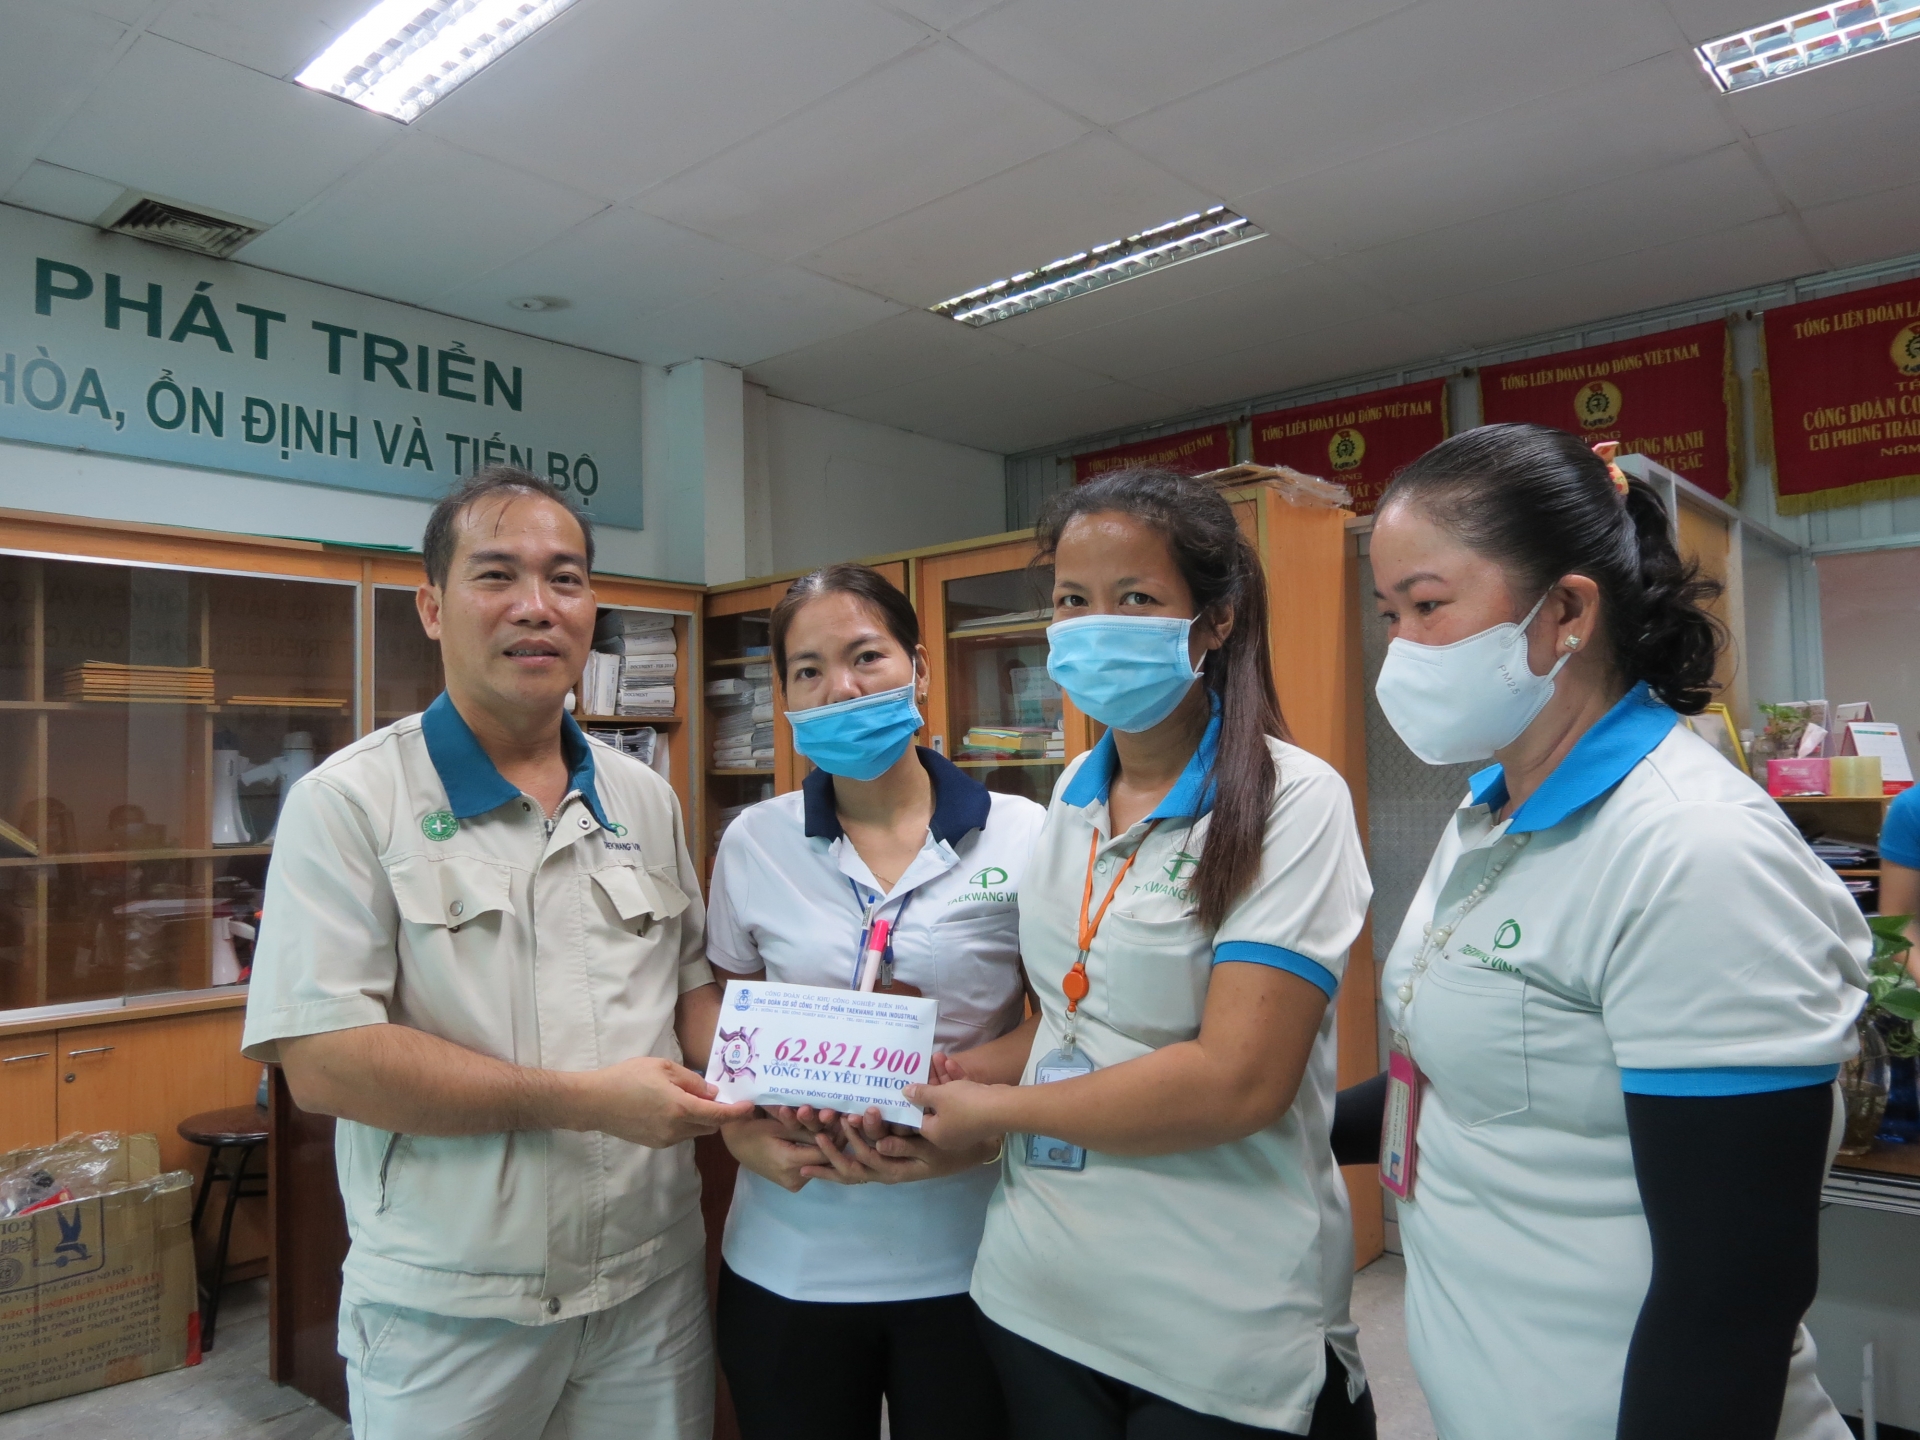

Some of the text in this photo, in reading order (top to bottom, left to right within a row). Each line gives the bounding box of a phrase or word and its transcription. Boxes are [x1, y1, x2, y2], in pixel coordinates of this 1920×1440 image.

[1833, 310, 1864, 331] LIÊN
[35, 257, 523, 412] PHÁT TRIỂN
[1530, 369, 1554, 387] LIÊN
[1587, 362, 1610, 379] LAO
[1674, 343, 1700, 362] NAM
[1336, 411, 1356, 427] LAO
[1409, 400, 1432, 416] NAM
[1803, 407, 1847, 431] CÔNG
[1849, 396, 1896, 424] ĐOÀN
[147, 369, 224, 438] ỔN
[241, 397, 358, 460] ĐỊNH
[373, 416, 435, 472] VÀ
[446, 432, 533, 476] TIẾN
[547, 451, 599, 505] BỘ
[1832, 424, 1882, 448] PHONG
[1497, 664, 1521, 695] PM2.5
[947, 891, 1004, 906] TAEKWANG
[767, 998, 781, 1006] ĐOÀN
[799, 1001, 813, 1009] CÔNG
[846, 1007, 874, 1016] TAEKWANG
[889, 1012, 919, 1021] INDUSTRIAL
[774, 1036, 921, 1076] 62.821.900
[763, 1064, 800, 1079] VÒNG
[804, 1069, 832, 1082] TAY
[834, 1070, 862, 1085] YÊU
[780, 1088, 805, 1096] CB-CNV
[806, 1089, 826, 1098] ĐÓNG
[827, 1091, 842, 1100] GÓP
[855, 1096, 871, 1104] TRỢ
[872, 1096, 893, 1106] ĐOÀN
[894, 1099, 912, 1108] VIÊN
